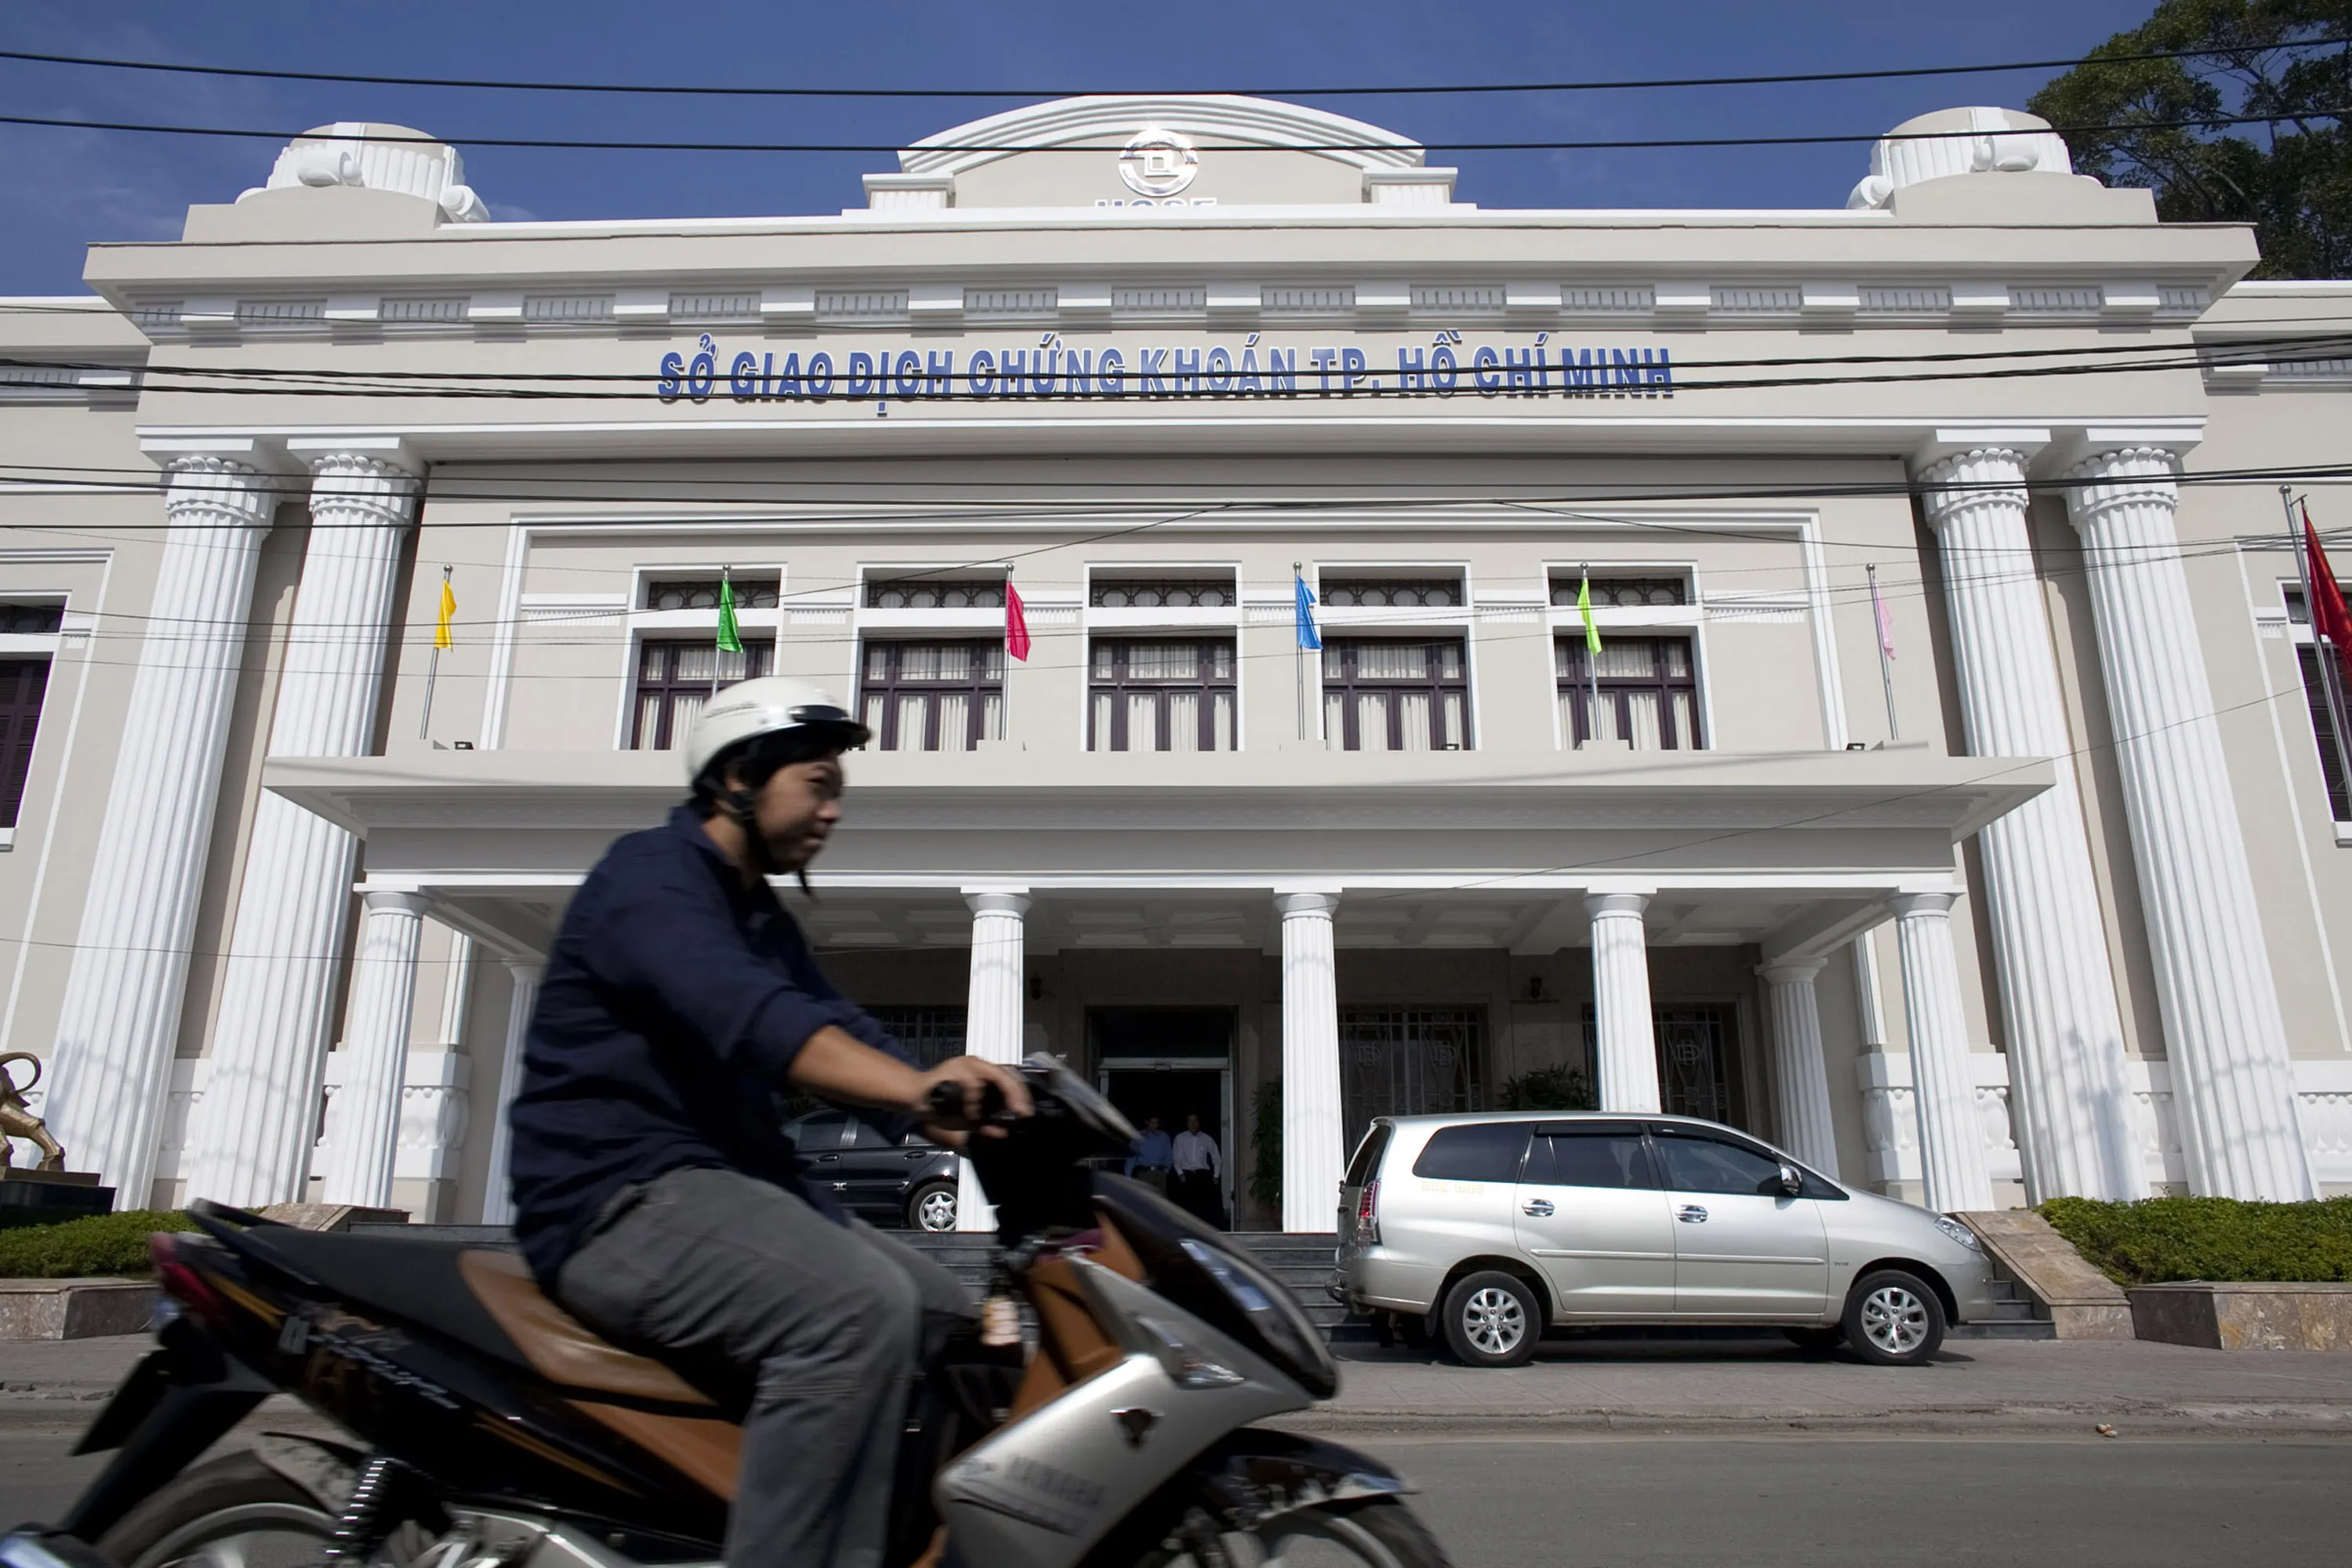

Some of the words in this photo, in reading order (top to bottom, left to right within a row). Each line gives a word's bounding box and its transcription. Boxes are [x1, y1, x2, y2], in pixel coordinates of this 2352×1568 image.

[656, 332, 717, 400] SỞ
[729, 350, 833, 399] GIAO
[846, 349, 954, 416] DỊCH
[967, 332, 1125, 397] CHỨNG
[1138, 333, 1298, 397] KHOÁN
[1311, 347, 1381, 395] TP.
[1396, 329, 1461, 396] HỒ
[1472, 332, 1549, 397] CHÍ
[1559, 346, 1675, 397] MINH
